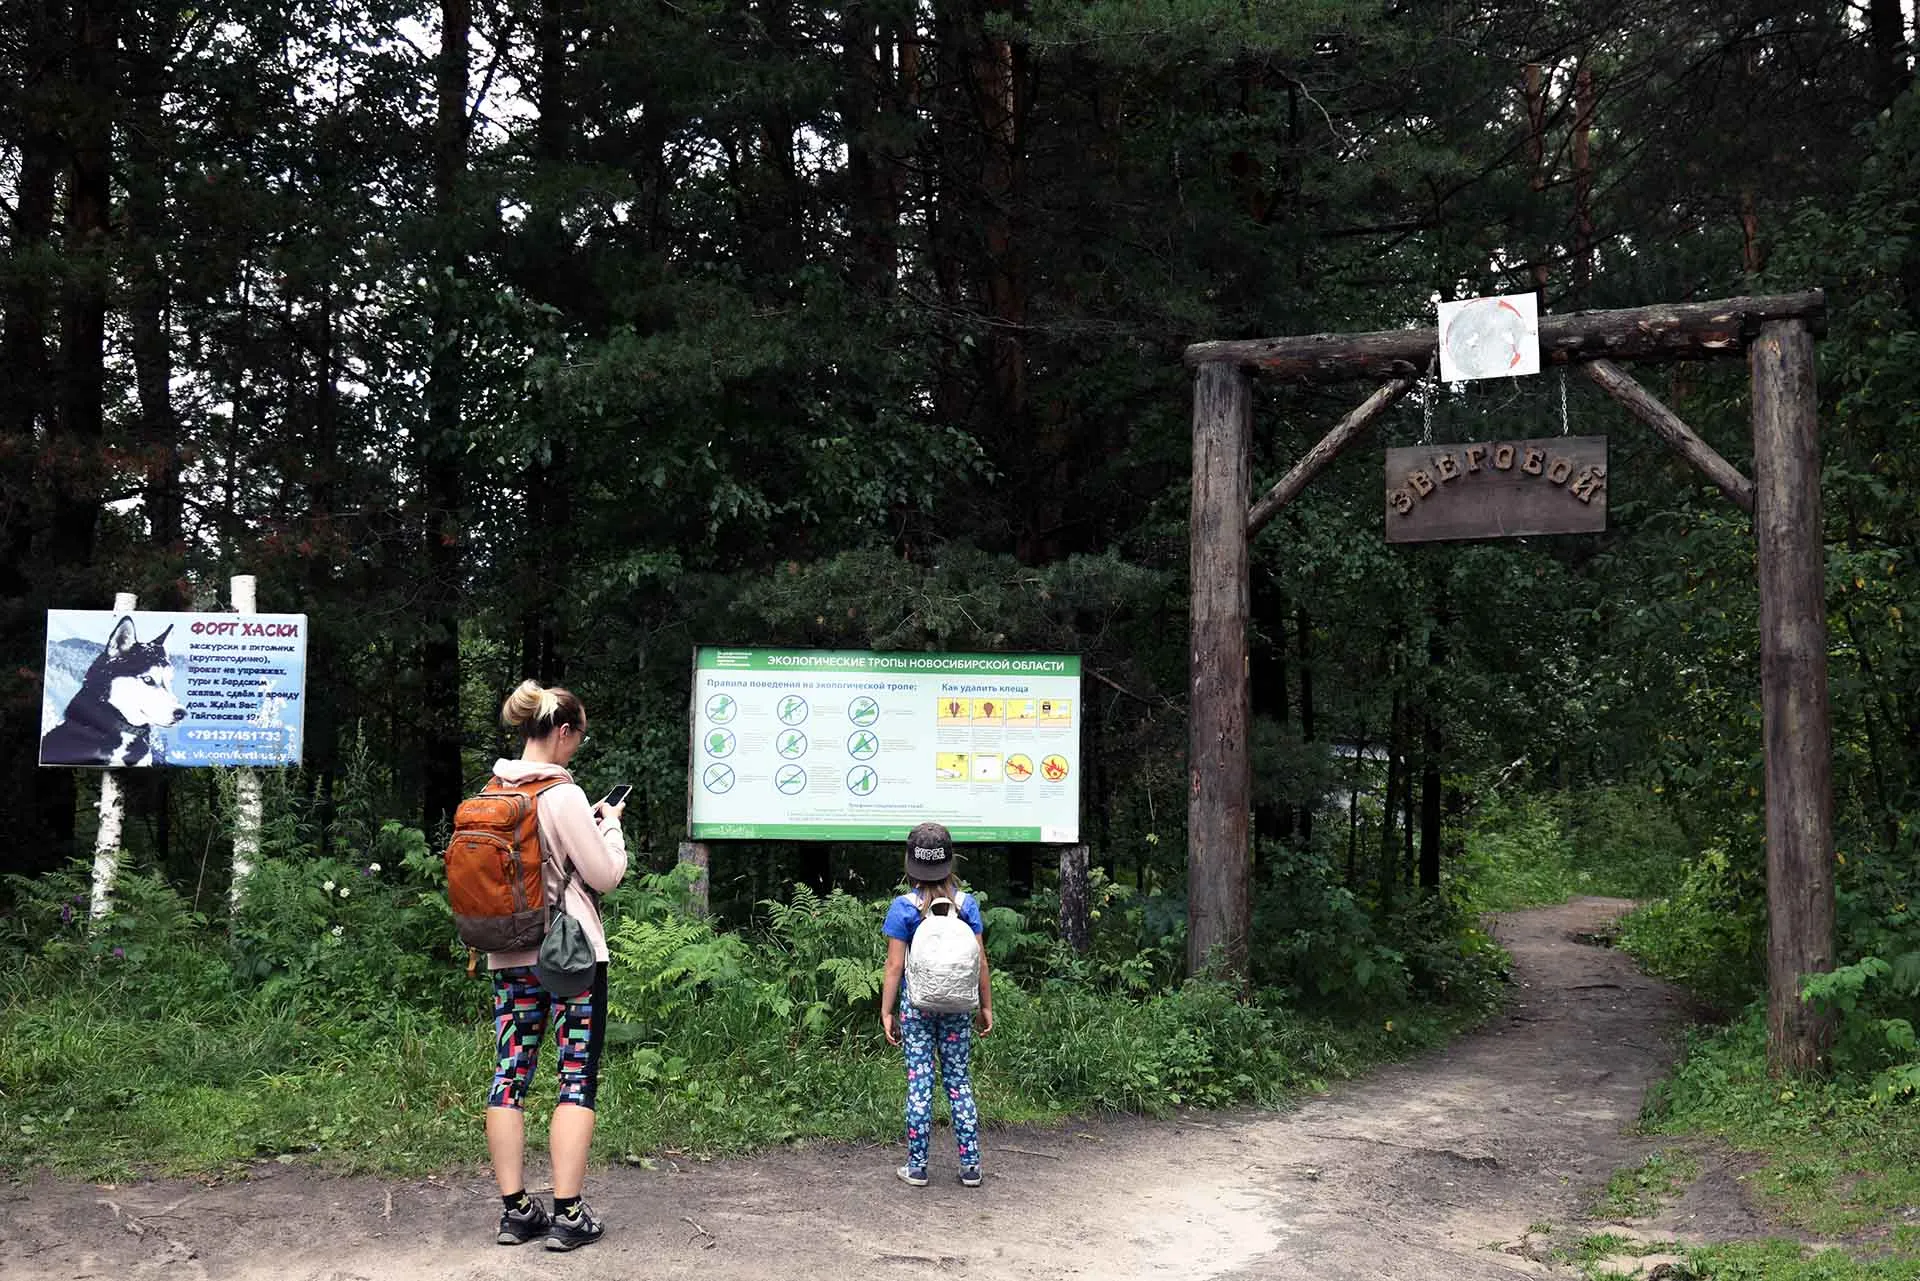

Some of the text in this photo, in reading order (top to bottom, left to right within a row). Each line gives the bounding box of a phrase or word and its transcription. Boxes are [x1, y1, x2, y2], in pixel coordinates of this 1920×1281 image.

[190, 621, 299, 638] ФОРТ ХАСКИ
[189, 643, 239, 652] экскурсии
[767, 655, 1065, 672] ЭКОЛОГИЧЕСКИЕ ТРОПЫ НОВОСИБИРСКОЙ ОБЛАСТИ
[188, 666, 221, 674] прокат
[238, 667, 287, 676] упряжках,
[187, 678, 211, 686] туры
[706, 679, 748, 688] Правила
[749, 681, 801, 689] поведения
[815, 682, 886, 690] экологической
[887, 684, 918, 692] тропе:
[226, 689, 256, 699] сдаём
[942, 684, 1029, 694] Как удалить клеща
[186, 702, 208, 710] дом.
[209, 701, 237, 711] Ждём
